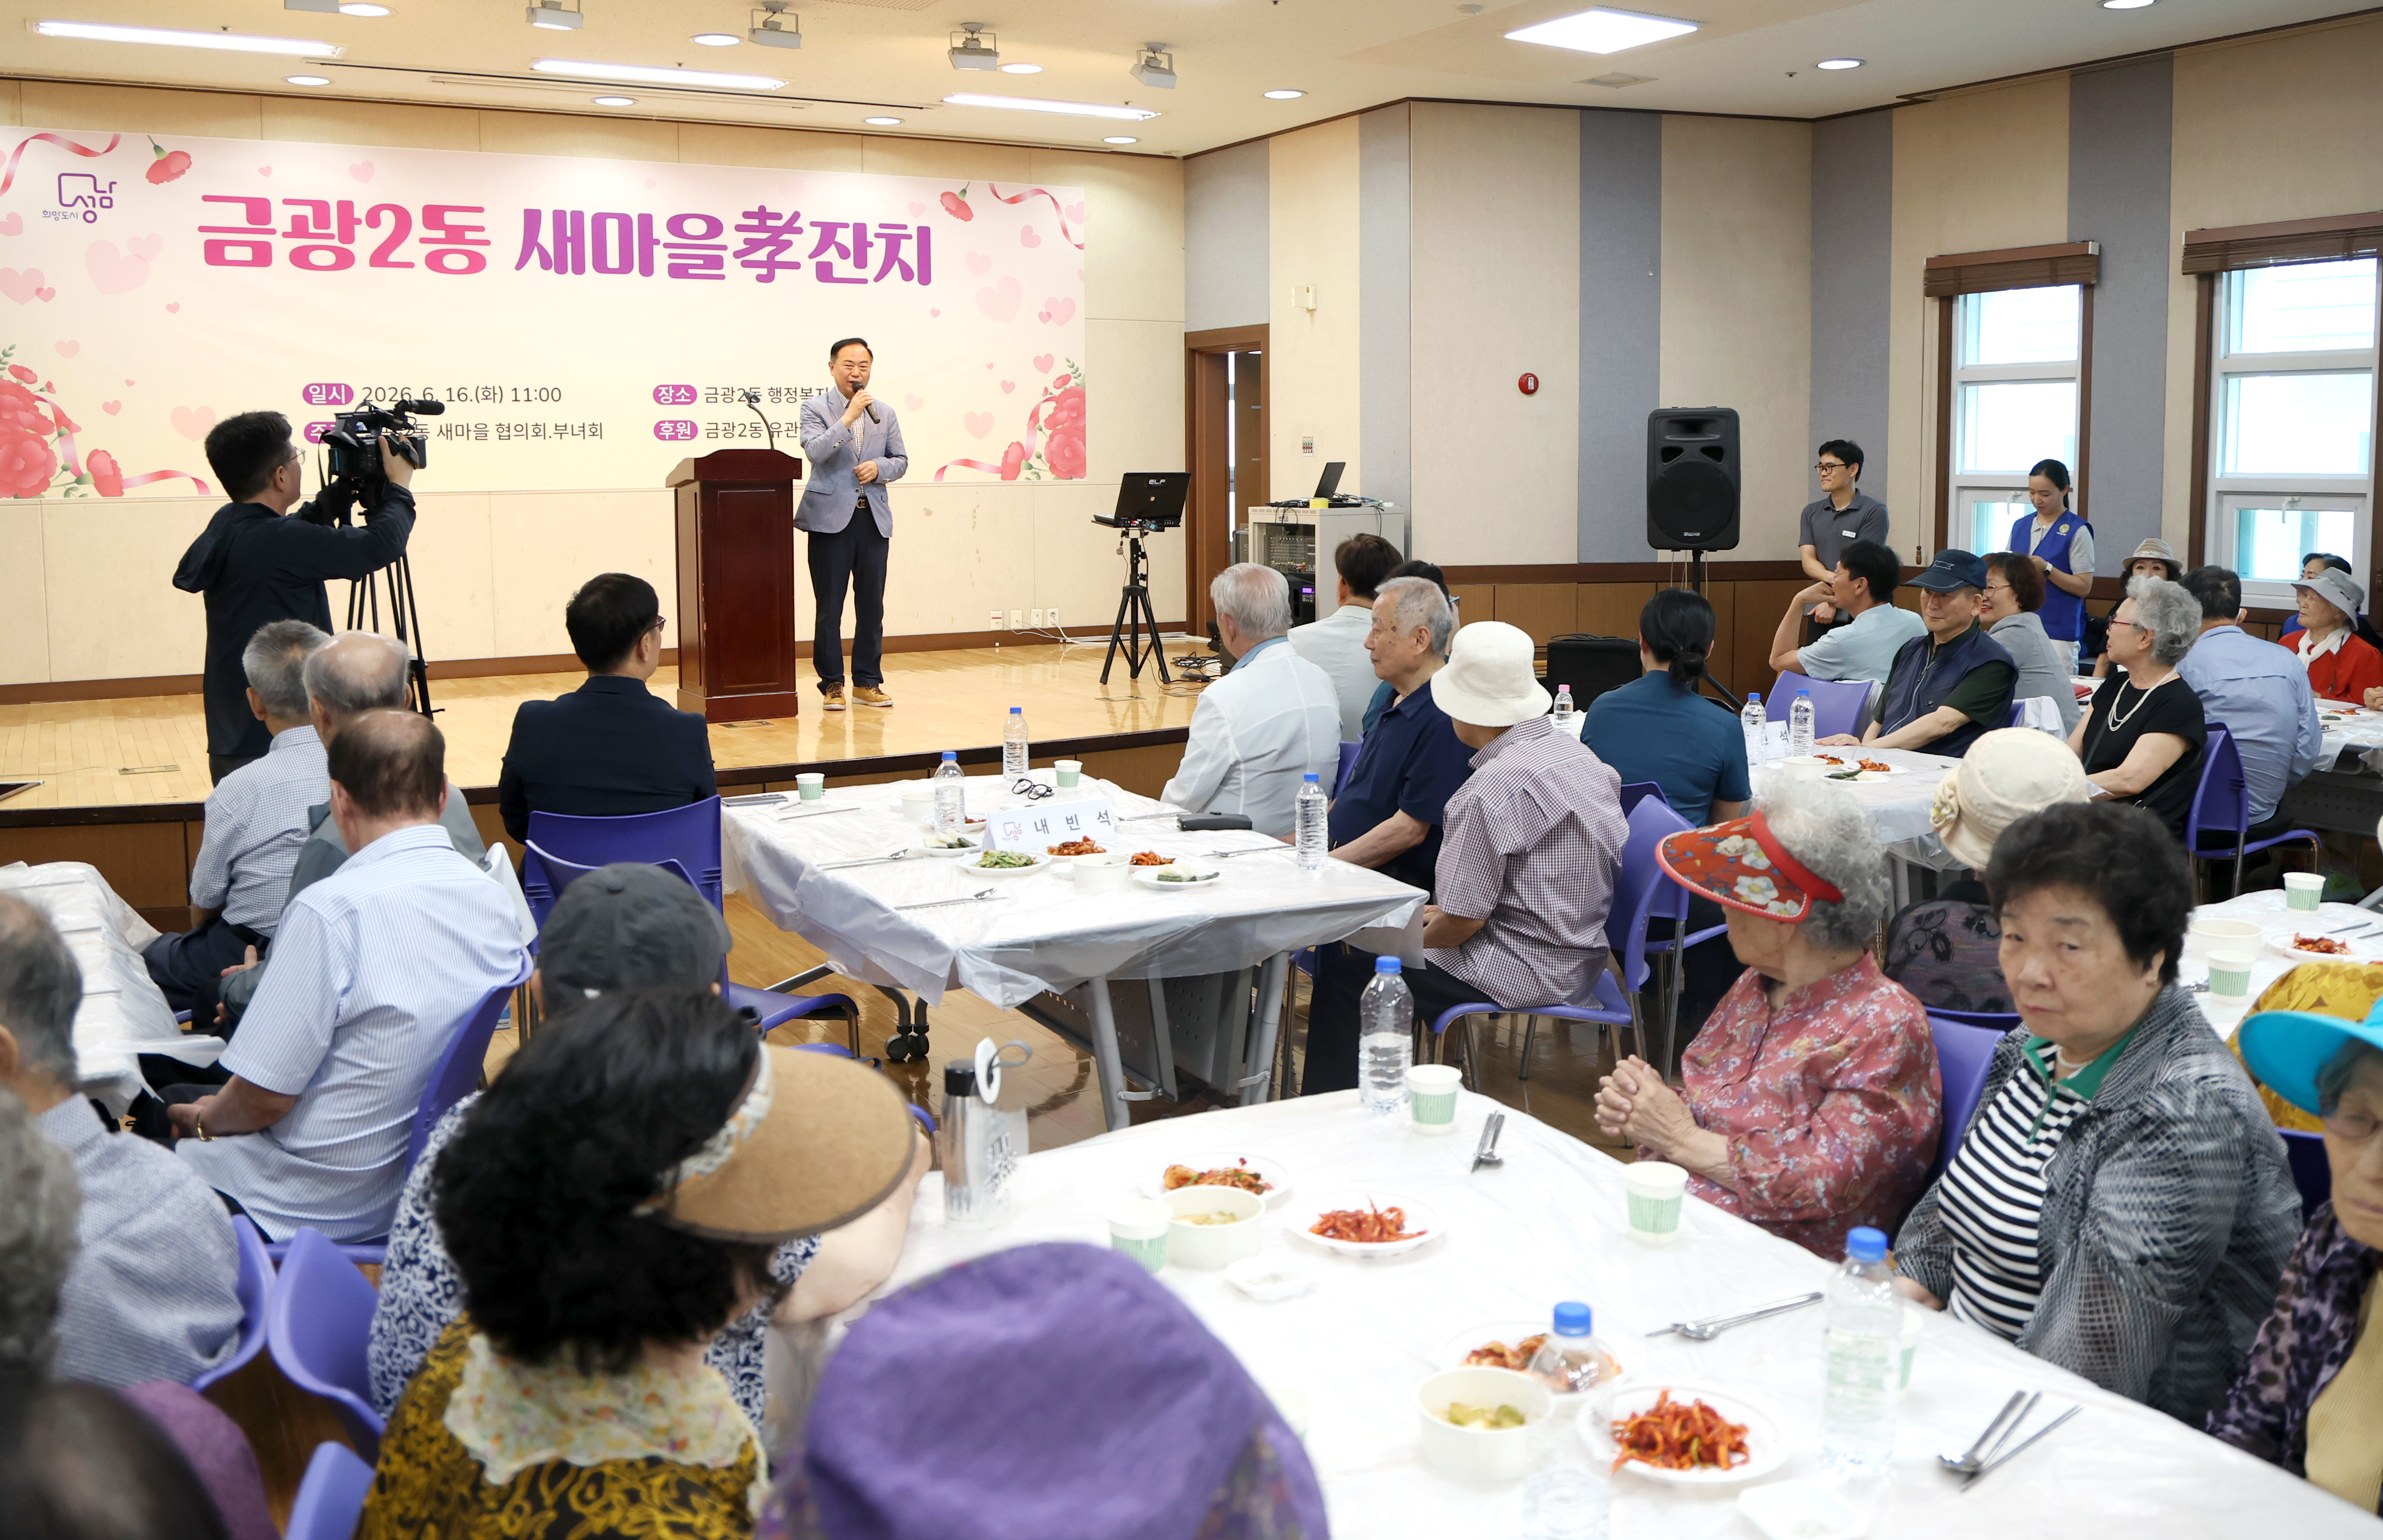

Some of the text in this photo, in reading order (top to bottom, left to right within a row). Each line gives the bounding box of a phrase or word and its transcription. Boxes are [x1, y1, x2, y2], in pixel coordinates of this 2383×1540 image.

[42, 209, 78, 221] 희망도시
[198, 195, 931, 286] 금광2동 새마을孝잔치
[308, 384, 345, 404] 일시
[446, 386, 503, 403] 16.(화)
[511, 387, 562, 402] 11:00
[658, 386, 691, 403] 장소
[310, 424, 336, 442] 주
[437, 423, 489, 441] 새마을
[495, 422, 603, 440] 협의회.부녀회
[659, 421, 691, 440] 후원
[705, 421, 763, 438] 금광2동
